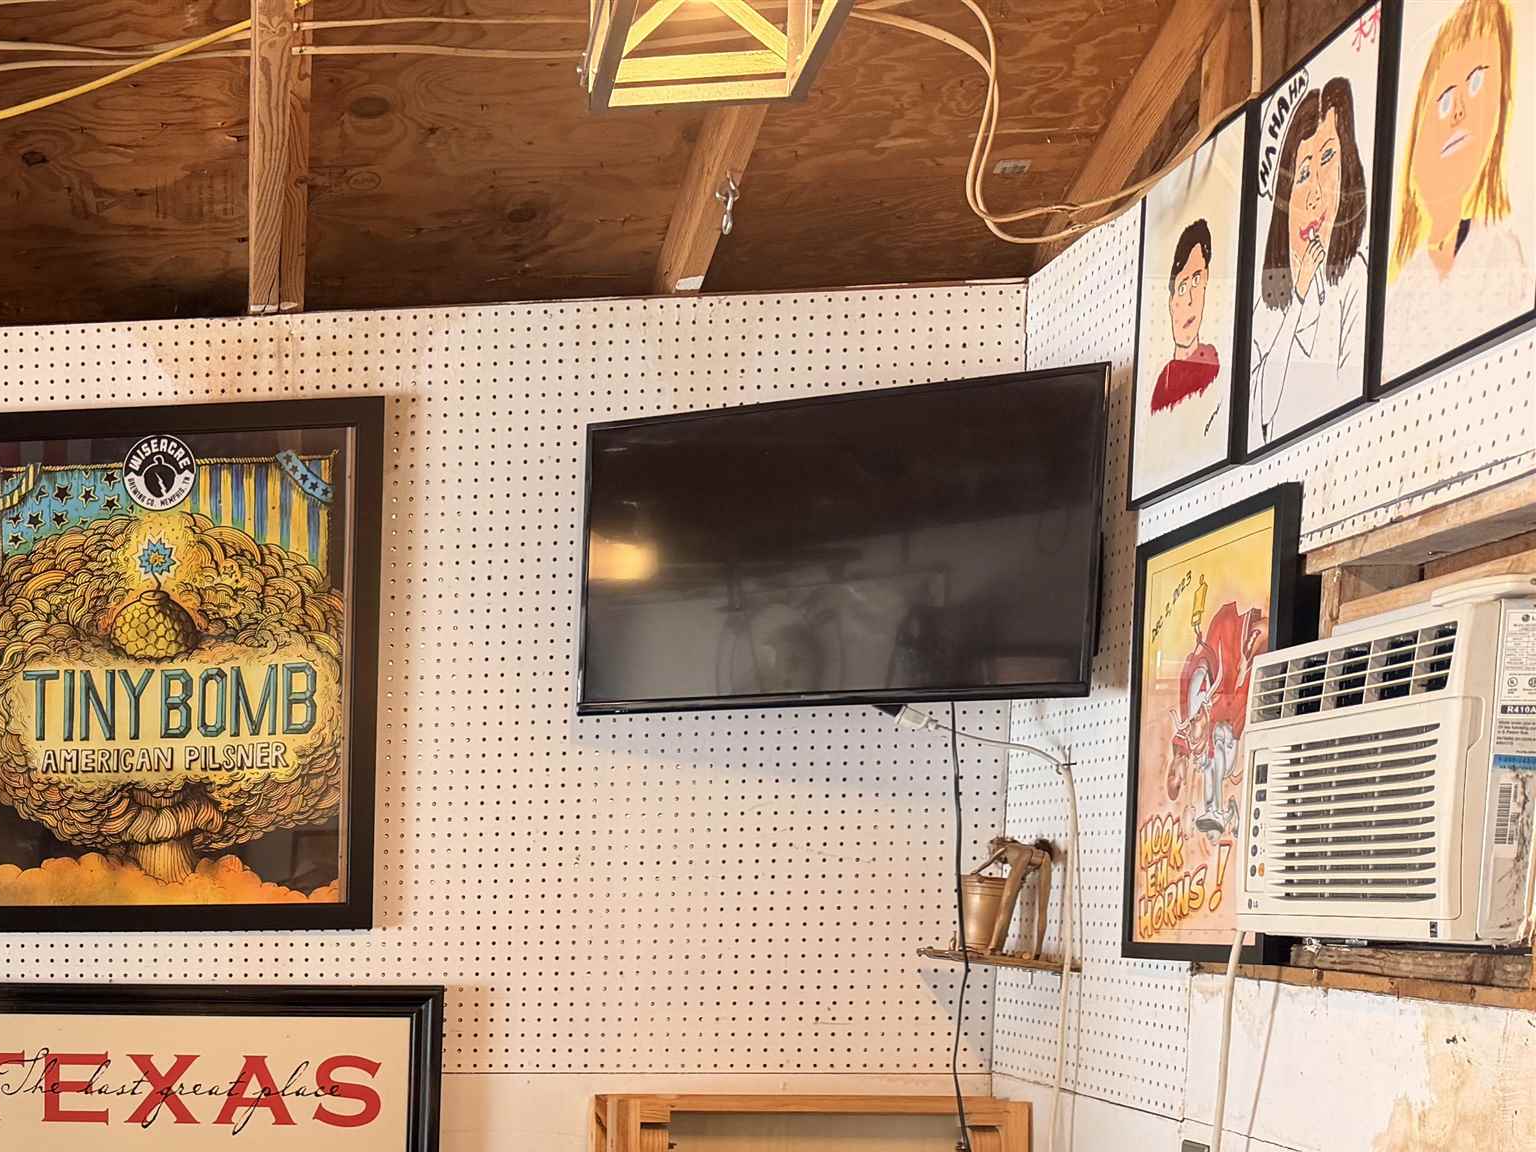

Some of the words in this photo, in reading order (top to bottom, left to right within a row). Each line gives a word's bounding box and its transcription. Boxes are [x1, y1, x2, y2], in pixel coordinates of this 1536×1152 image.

[1288, 75, 1306, 104] HA
[1268, 96, 1290, 140] HA
[1260, 146, 1277, 188] HA
[128, 439, 191, 471] WISEACRE
[22, 667, 155, 741] TINY
[160, 661, 317, 740] BOMB
[41, 746, 174, 774] AMERICAN
[184, 741, 289, 773] PILSNER
[1138, 812, 1184, 870] HOOK
[77, 1059, 149, 1097] last
[140, 1071, 251, 1129] great
[232, 1060, 343, 1136] place
